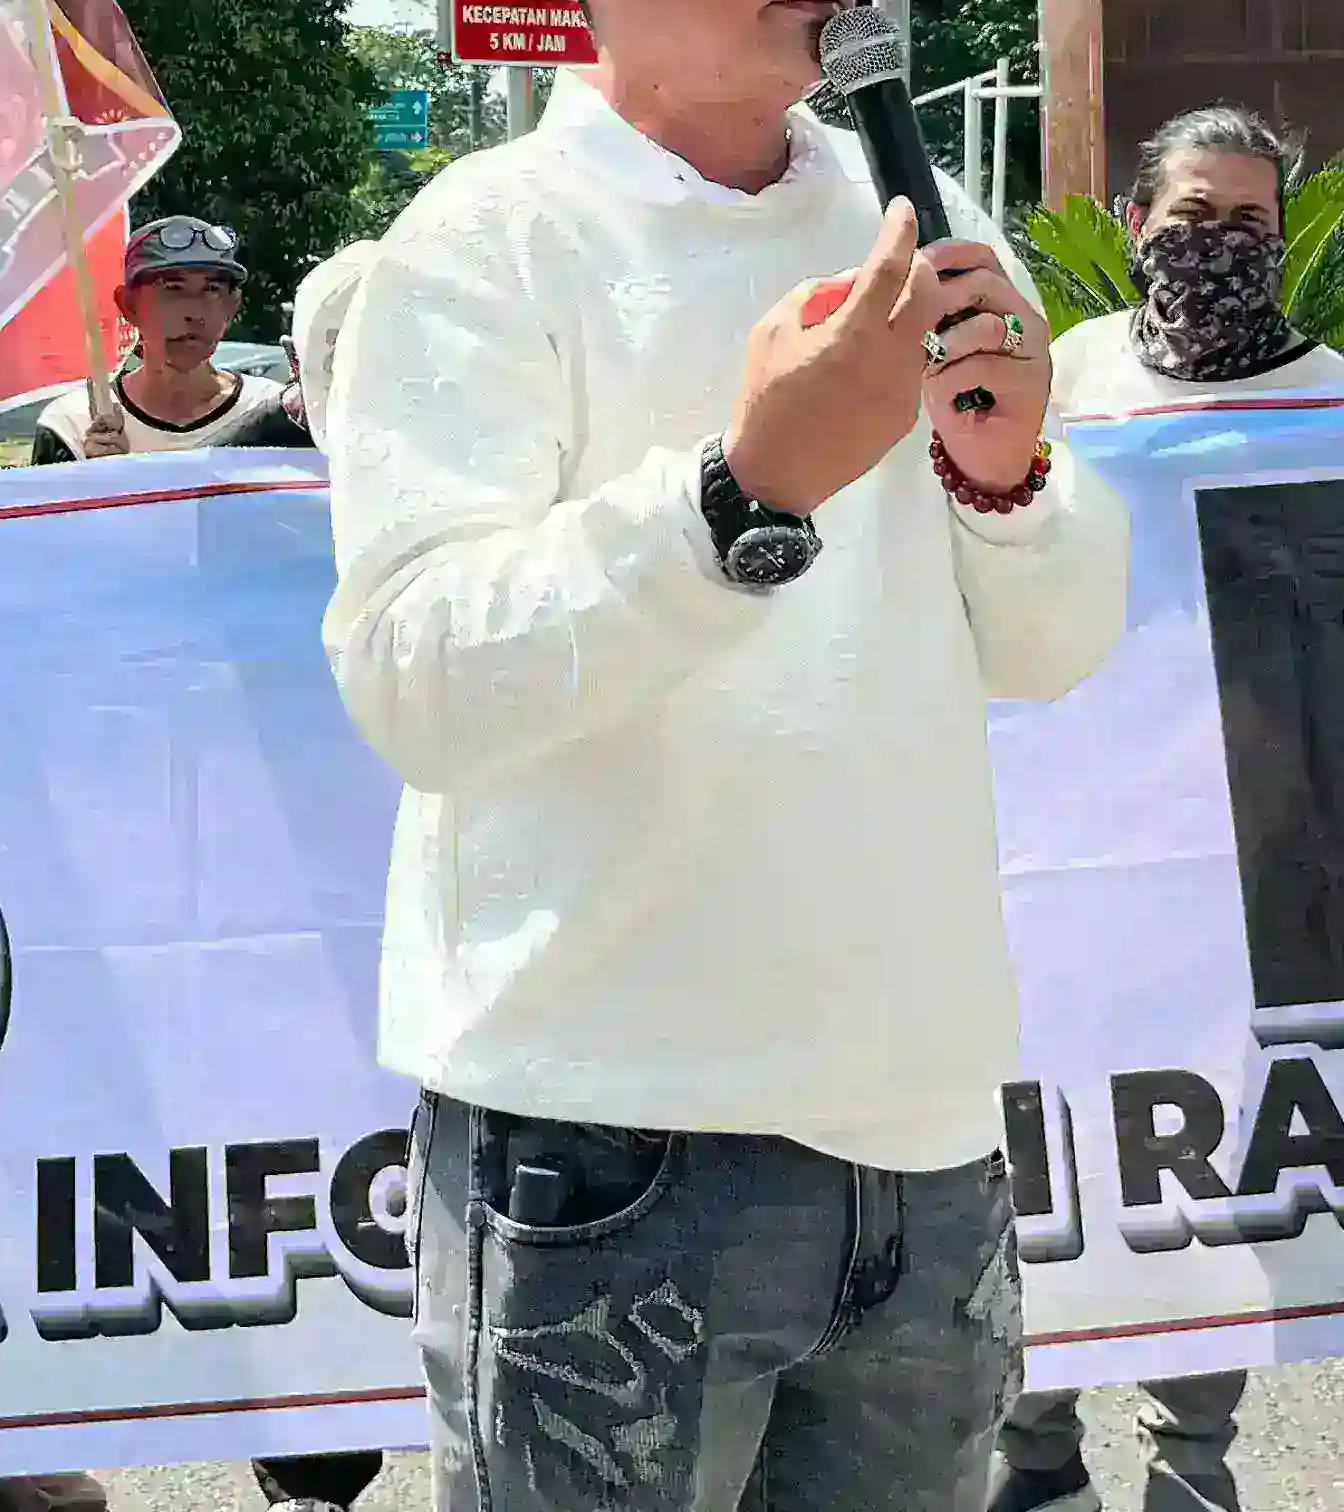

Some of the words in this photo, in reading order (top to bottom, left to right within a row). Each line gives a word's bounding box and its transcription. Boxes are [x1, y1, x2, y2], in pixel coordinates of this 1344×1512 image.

[462, 5, 546, 26] KECEPATAN
[489, 33, 499, 50] 5
[502, 33, 526, 51] KM
[536, 34, 566, 52] JAM
